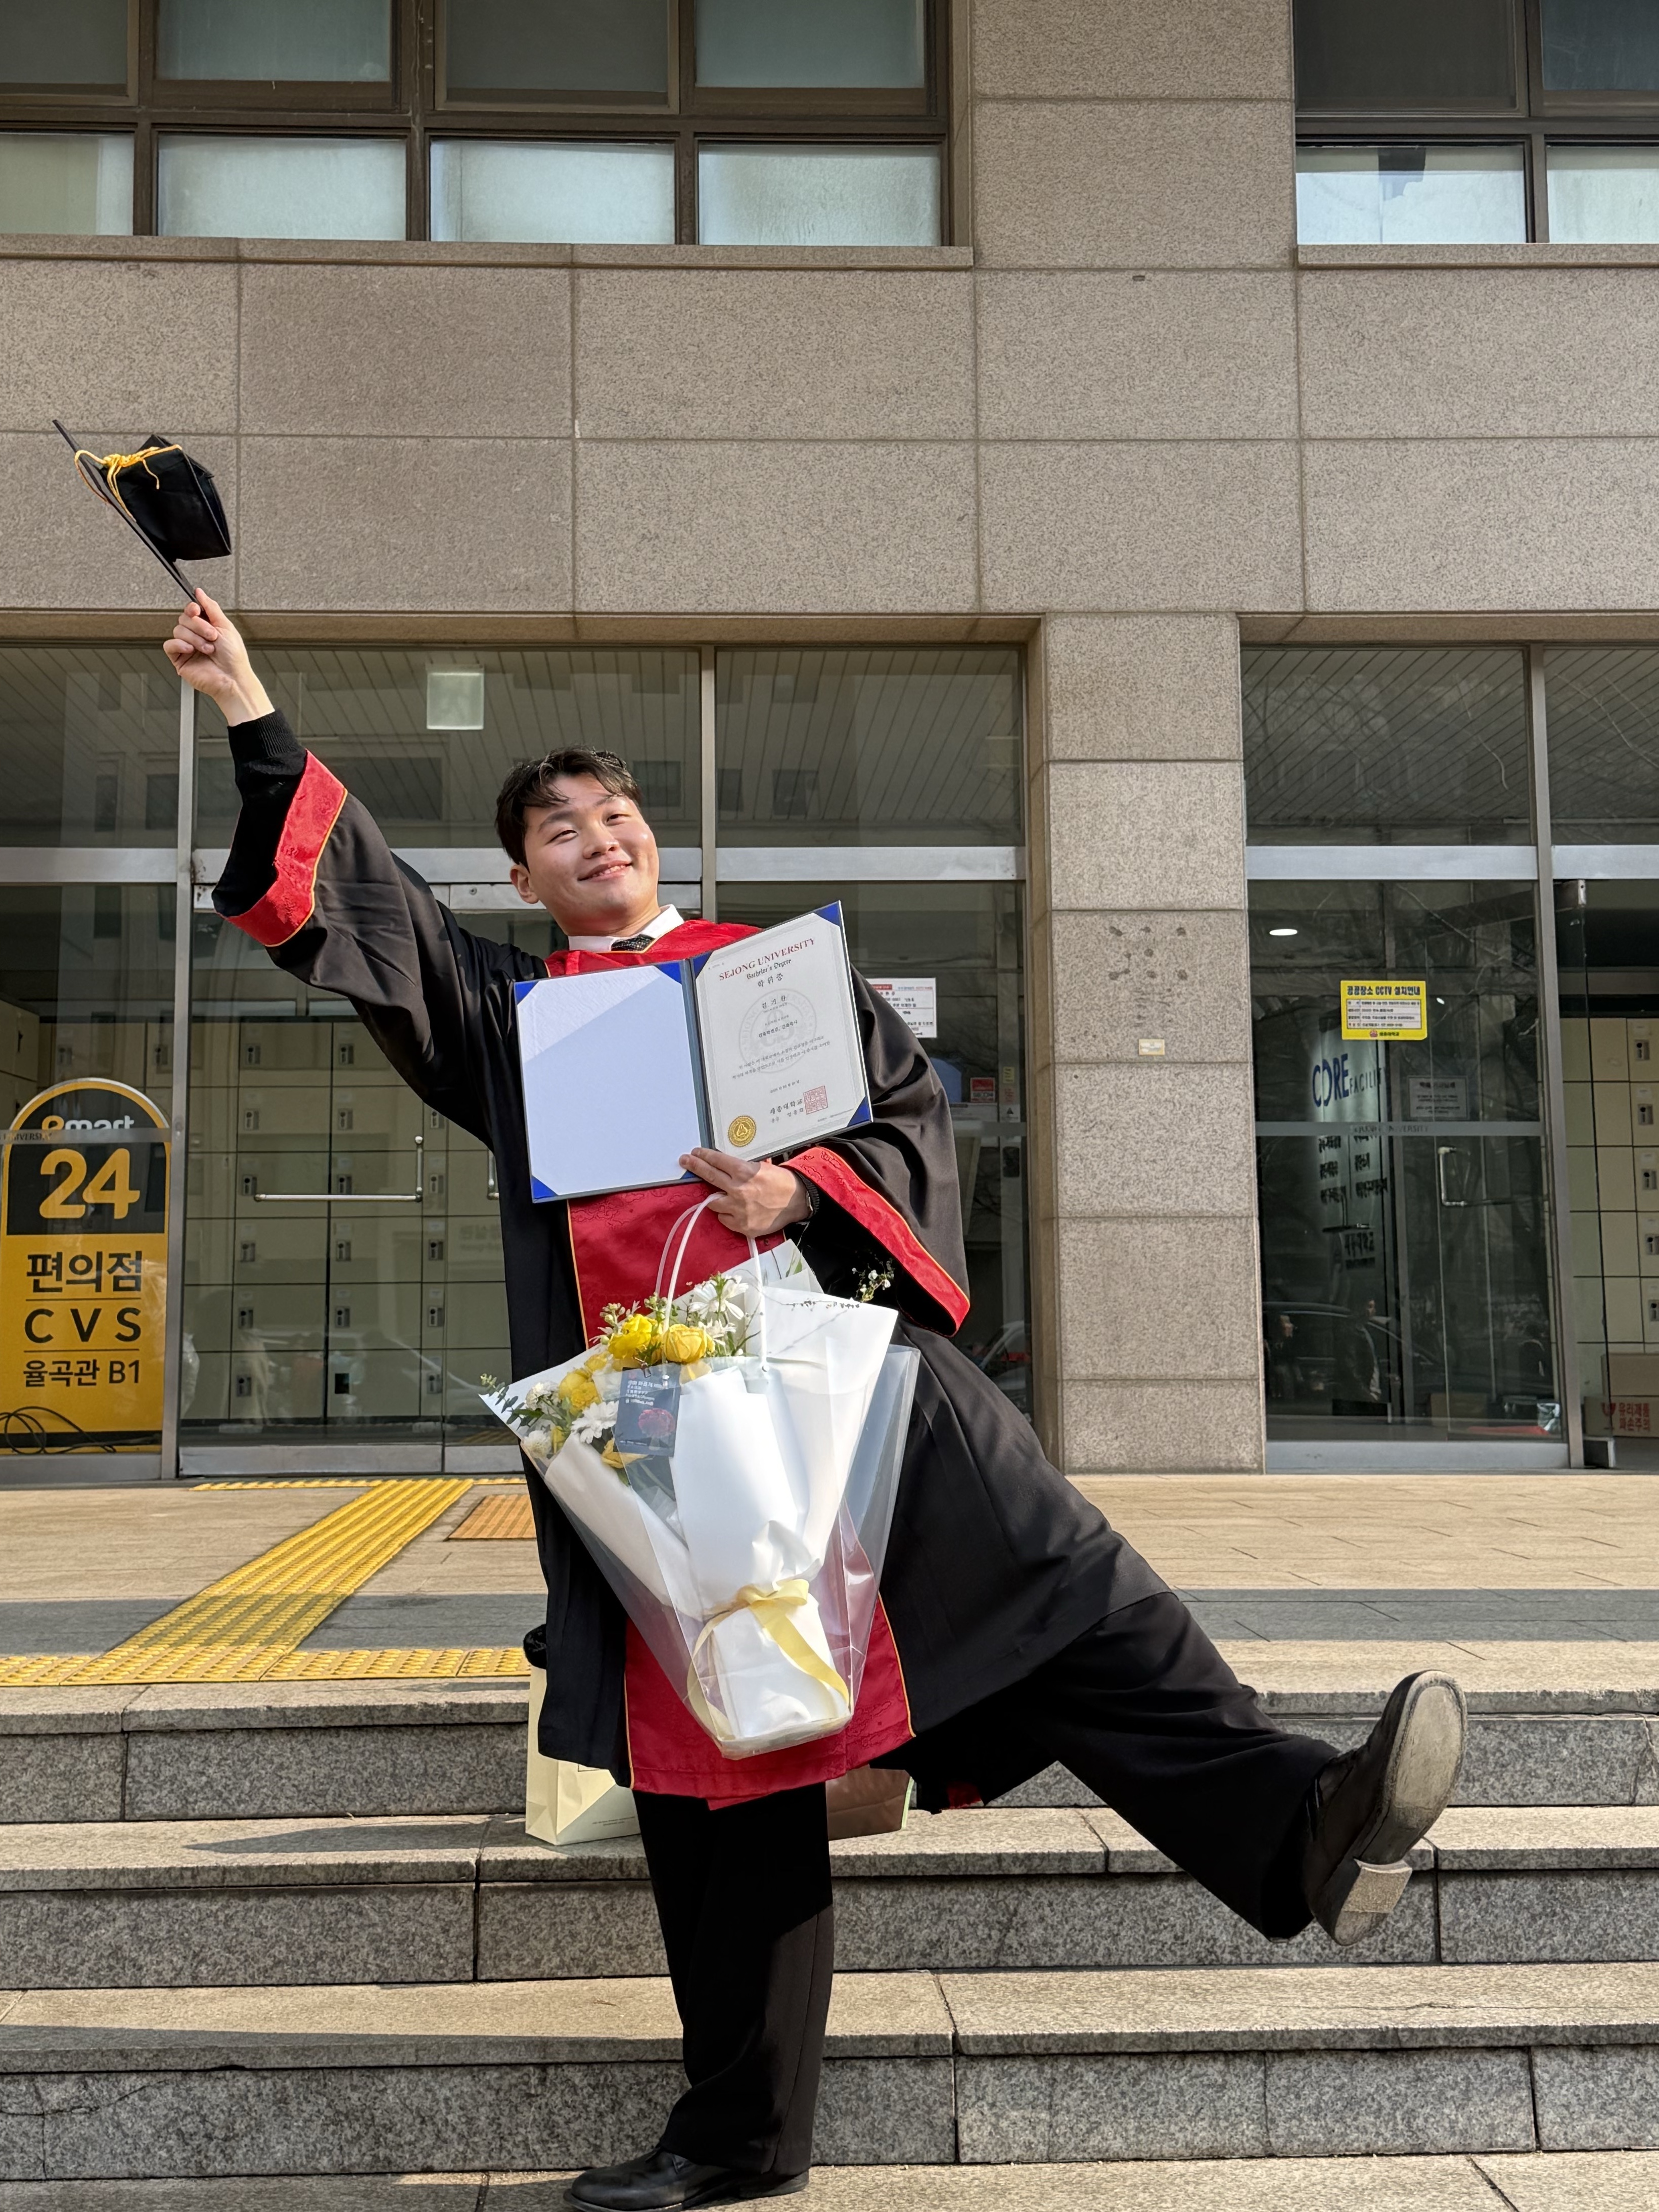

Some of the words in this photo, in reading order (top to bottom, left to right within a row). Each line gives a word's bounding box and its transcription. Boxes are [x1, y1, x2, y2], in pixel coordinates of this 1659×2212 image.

[719, 961, 755, 981] SEJONG
[758, 938, 815, 965] UNIVERSITY
[747, 964, 772, 980] Bachelor's
[773, 959, 792, 970] Degree
[1347, 985, 1373, 996] 공공장소
[1375, 986, 1392, 996] CCTV
[1312, 1053, 1349, 1108] CORE
[4, 1132, 52, 1141] IVERSI
[41, 1115, 134, 1130] emart
[39, 1148, 140, 1219] 24
[26, 1251, 143, 1293] 편의점
[23, 1359, 100, 1388] 율곡관
[109, 1360, 140, 1384] B1
